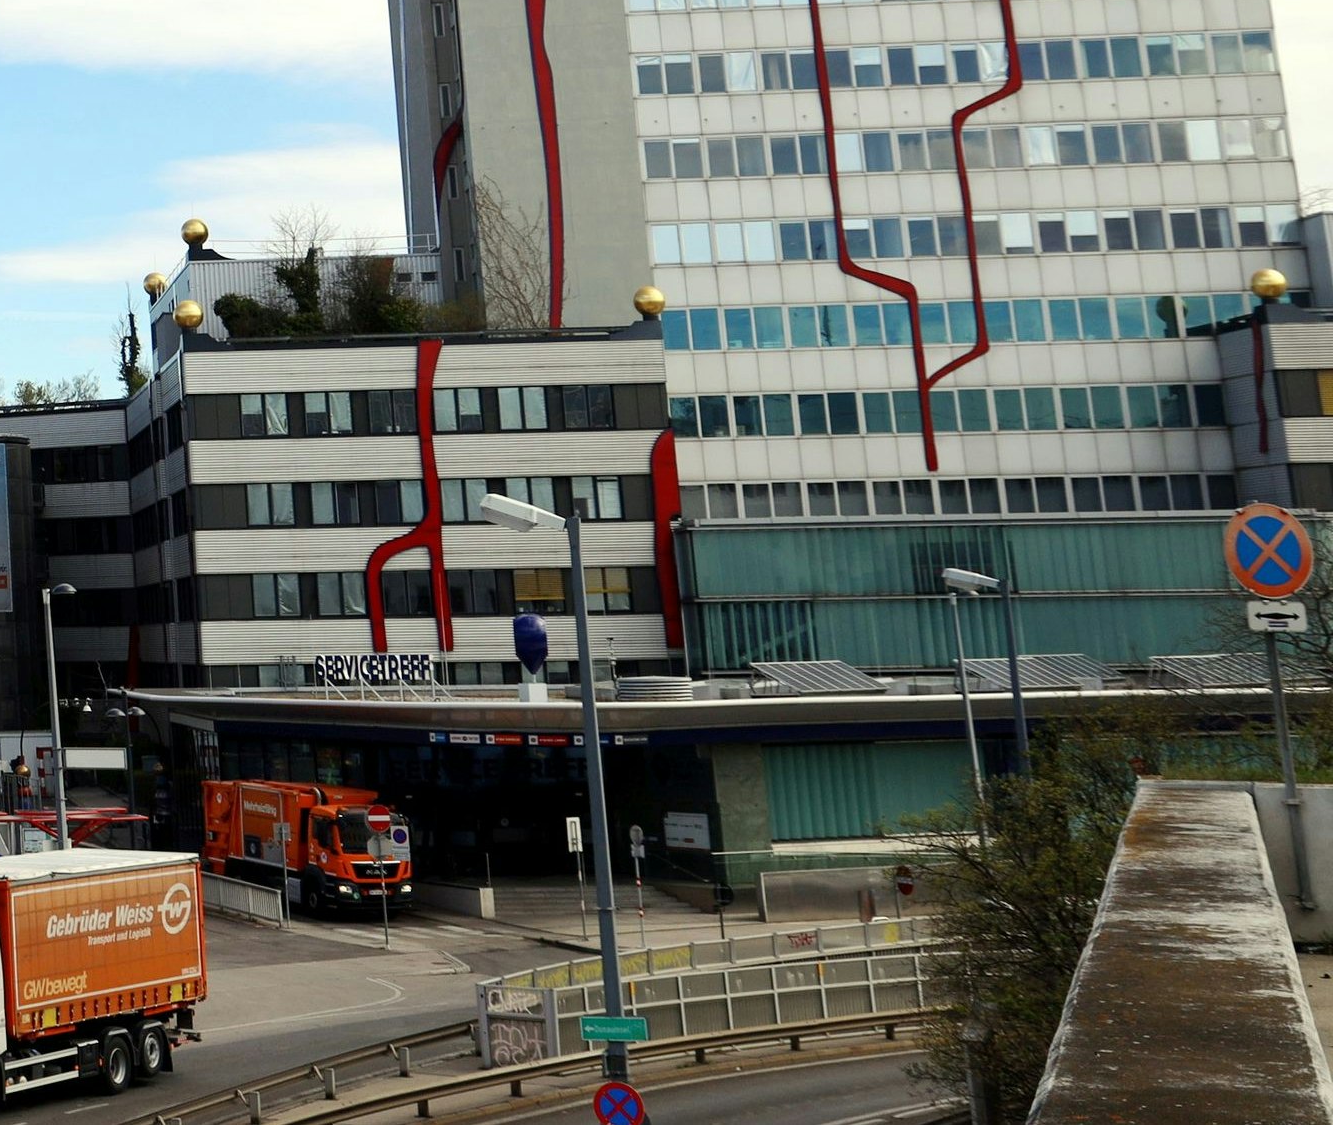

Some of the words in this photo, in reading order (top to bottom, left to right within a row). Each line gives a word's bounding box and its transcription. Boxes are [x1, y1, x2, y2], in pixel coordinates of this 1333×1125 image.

[314, 654, 431, 680] SERVICETREFF
[46, 909, 113, 938] Gebrüder
[115, 903, 154, 927] Weiss
[88, 932, 116, 946] Transport
[116, 931, 128, 942] und
[129, 927, 152, 941] Logistik
